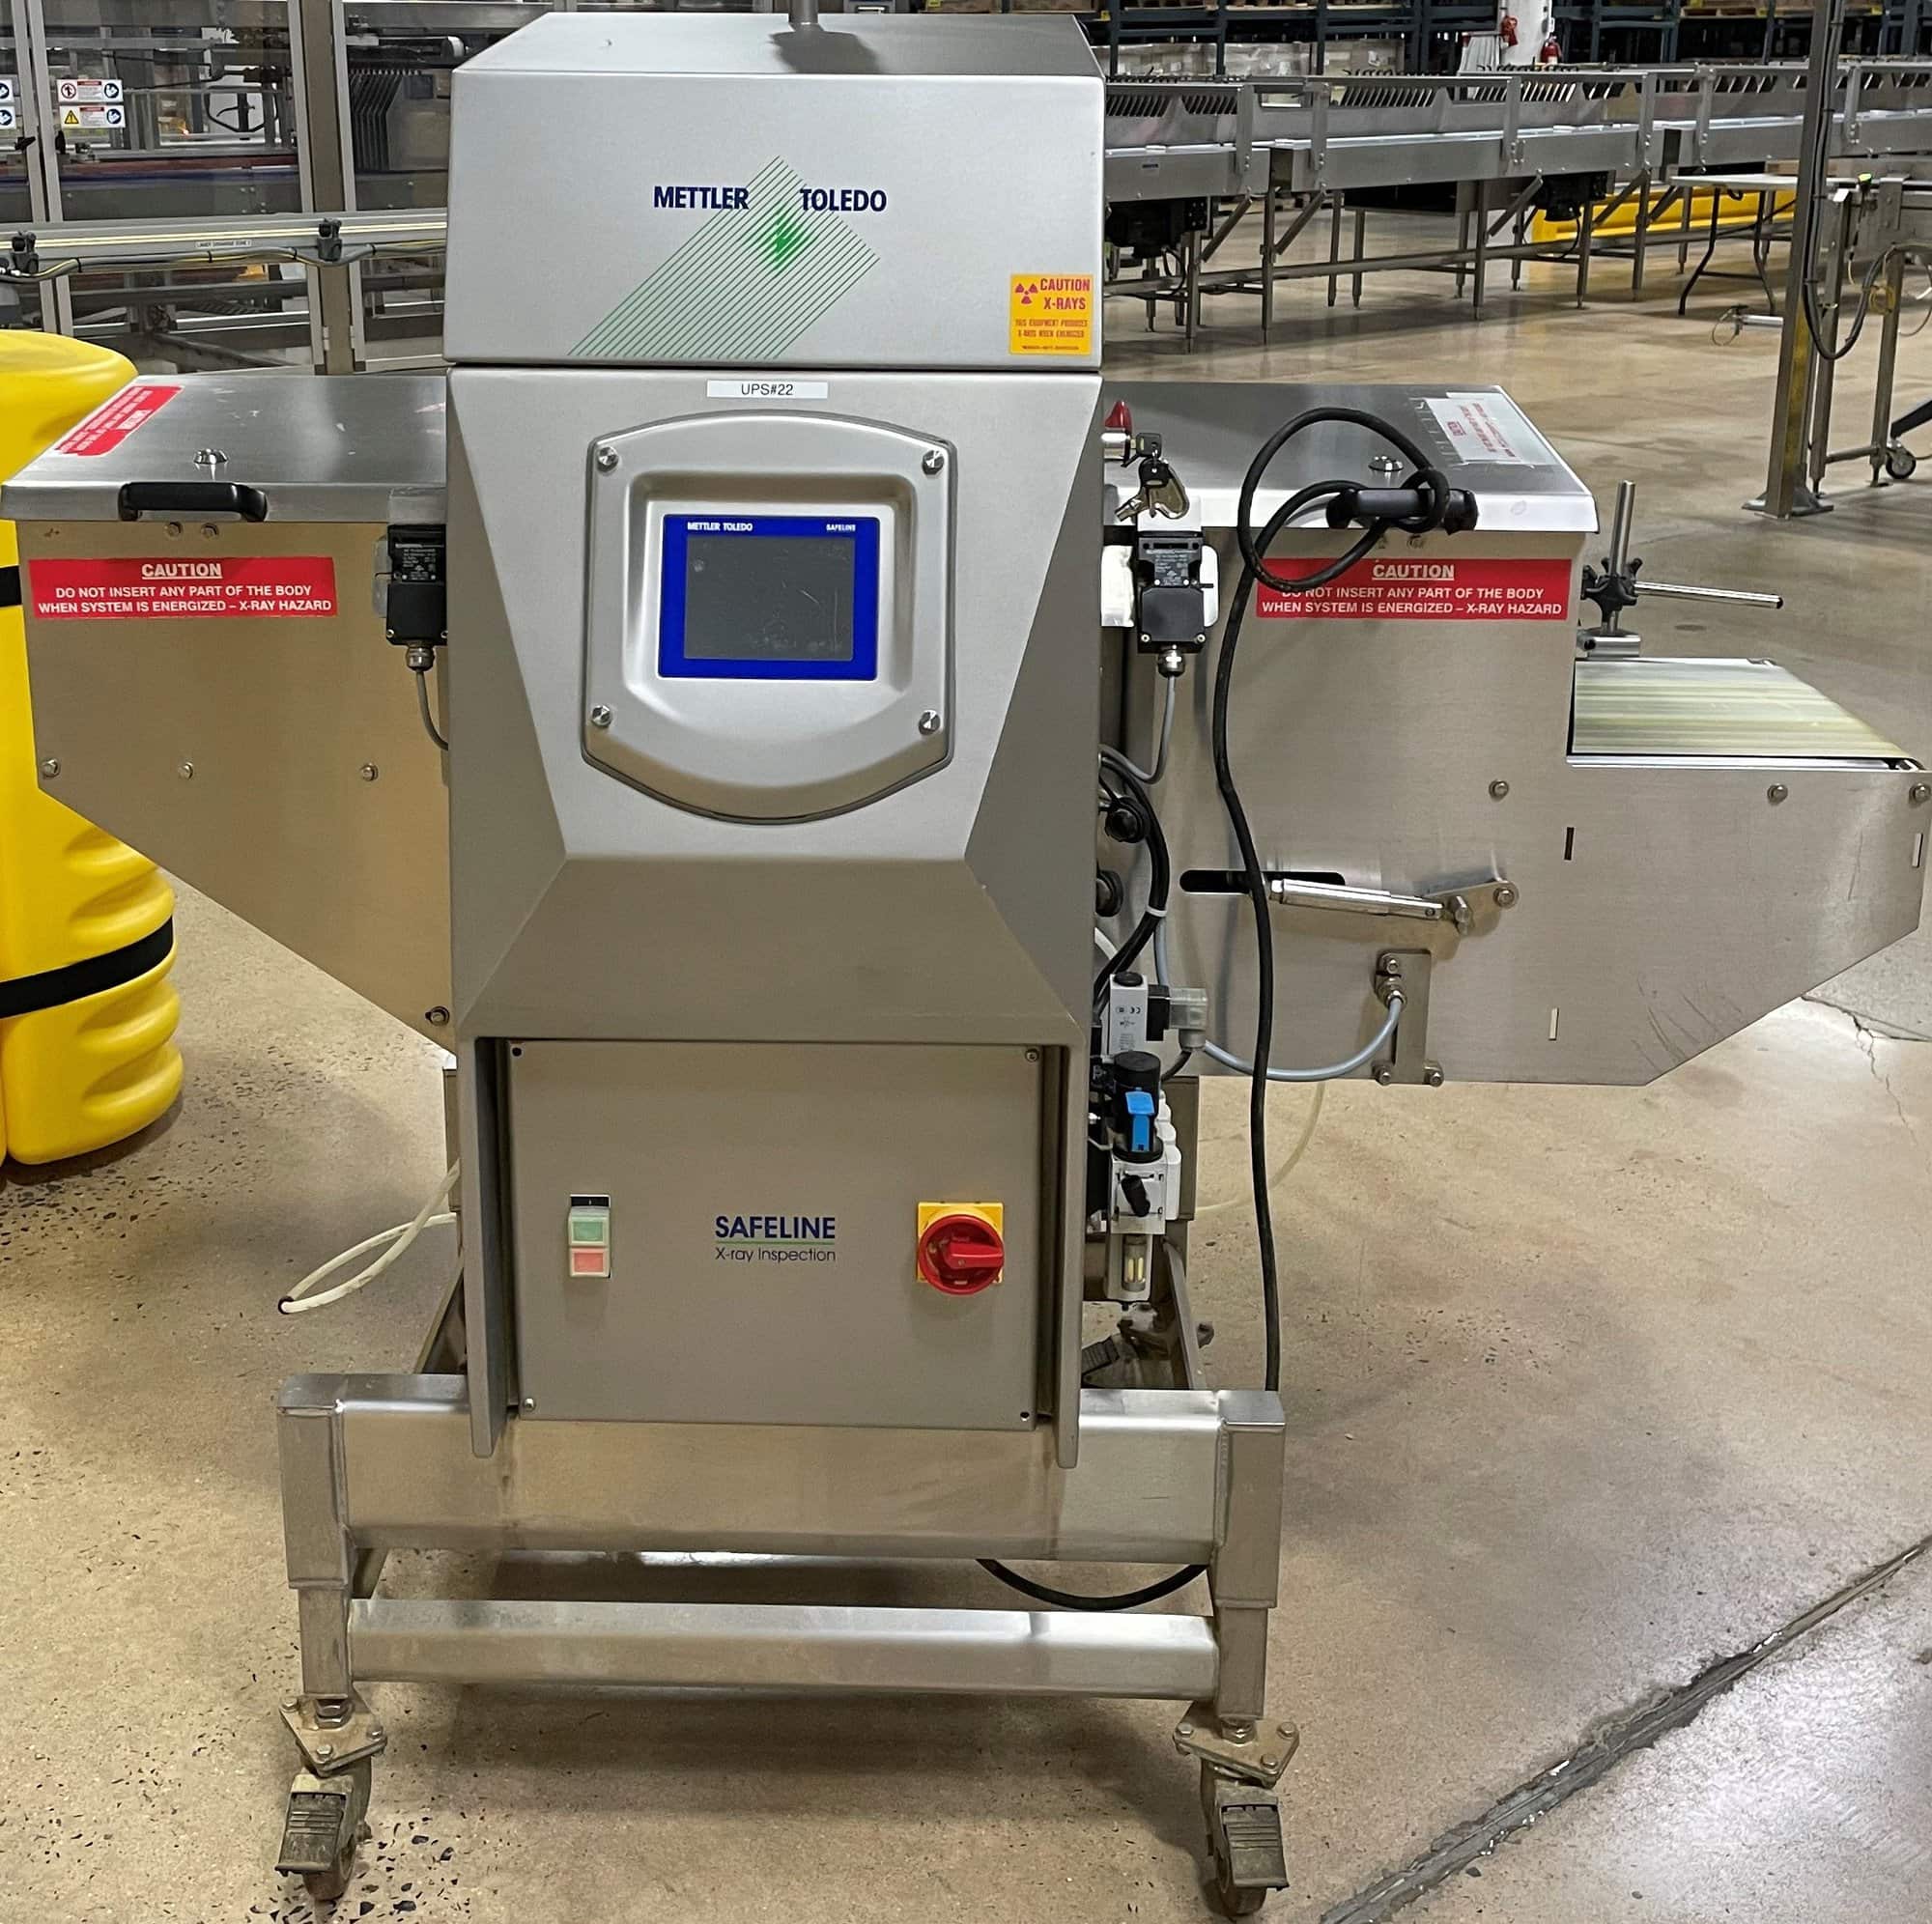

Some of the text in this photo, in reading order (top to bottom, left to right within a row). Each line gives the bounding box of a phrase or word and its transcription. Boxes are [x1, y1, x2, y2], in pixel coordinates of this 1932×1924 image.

[653, 185, 887, 212] METTLER TOLEDO
[1040, 277, 1091, 291] CAUTION
[1043, 297, 1086, 309] X-RAYS
[741, 383, 793, 396] UPS#22
[687, 522, 753, 531] METTLER TOLEDO
[141, 563, 223, 580] CAUTION
[1372, 564, 1455, 580] CAUTION
[55, 585, 312, 598] DO NOT INSERT ANY PART OF THE BODY
[1305, 587, 1332, 598] NOT
[1336, 587, 1383, 598] INSERT
[1387, 587, 1413, 598] ANY
[1418, 588, 1452, 598] PART
[1455, 588, 1473, 599] OF
[1477, 588, 1503, 599] THE
[1506, 588, 1544, 599] BODY
[39, 603, 77, 613] WHEN
[81, 602, 132, 612] SYSTEM
[136, 602, 149, 611] IS
[152, 601, 226, 611] ENERGIZED
[239, 601, 275, 610] X-RAY
[278, 601, 332, 610] HAZARD
[1262, 602, 1301, 612] WHEN
[1305, 602, 1357, 612] SYSTEM
[1361, 602, 1374, 612] IS
[1378, 602, 1453, 613] ENERGIZED
[1466, 603, 1504, 613] X-RAY
[1507, 604, 1562, 614] HAZARD
[715, 1216, 836, 1238] SAFELINE
[715, 1247, 836, 1262] X-ray Inspection
